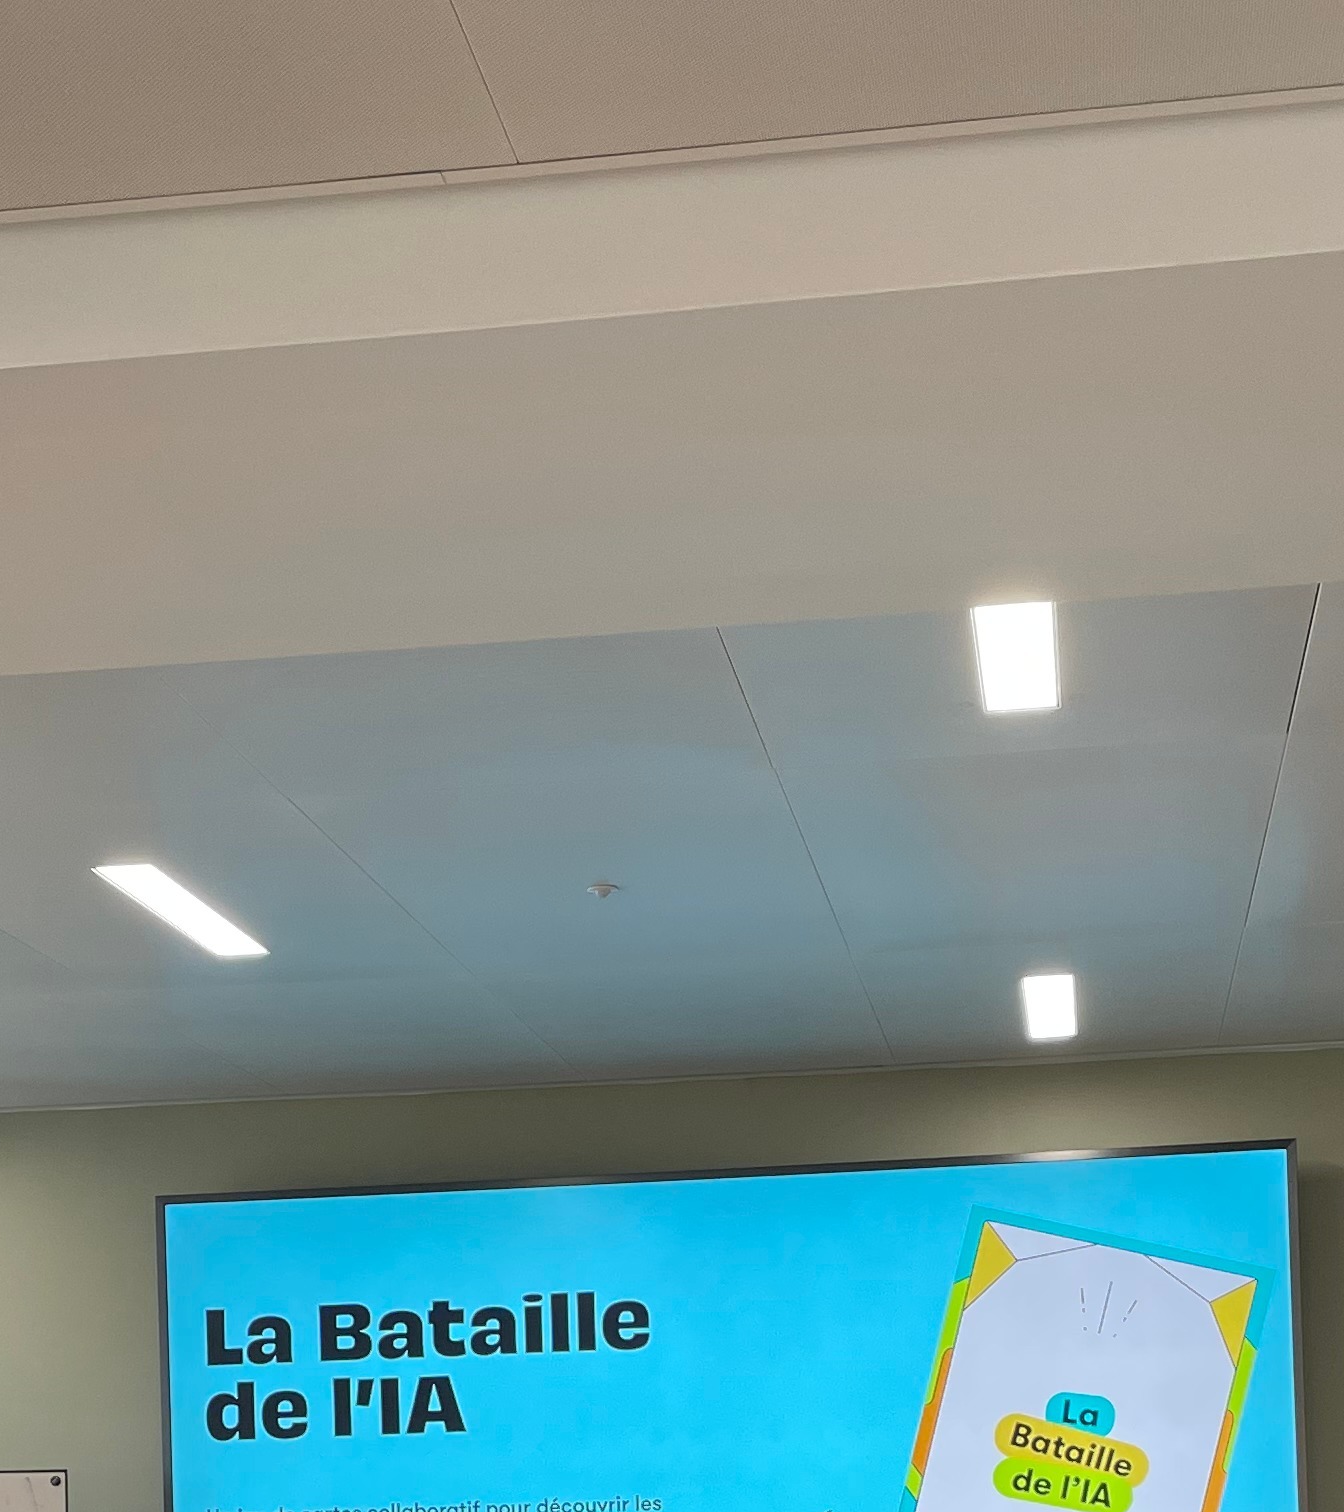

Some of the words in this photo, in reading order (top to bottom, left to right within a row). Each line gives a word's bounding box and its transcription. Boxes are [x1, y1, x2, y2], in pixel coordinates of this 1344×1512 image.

[205, 1308, 293, 1366] La
[317, 1291, 650, 1362] Bataille
[206, 1381, 308, 1441] de
[333, 1375, 466, 1437] l’IA
[1063, 1399, 1099, 1427] La
[1011, 1422, 1132, 1477] Bataille
[636, 1494, 662, 1511] les
[1012, 1468, 1052, 1495] de
[1061, 1474, 1111, 1508] l’IA
